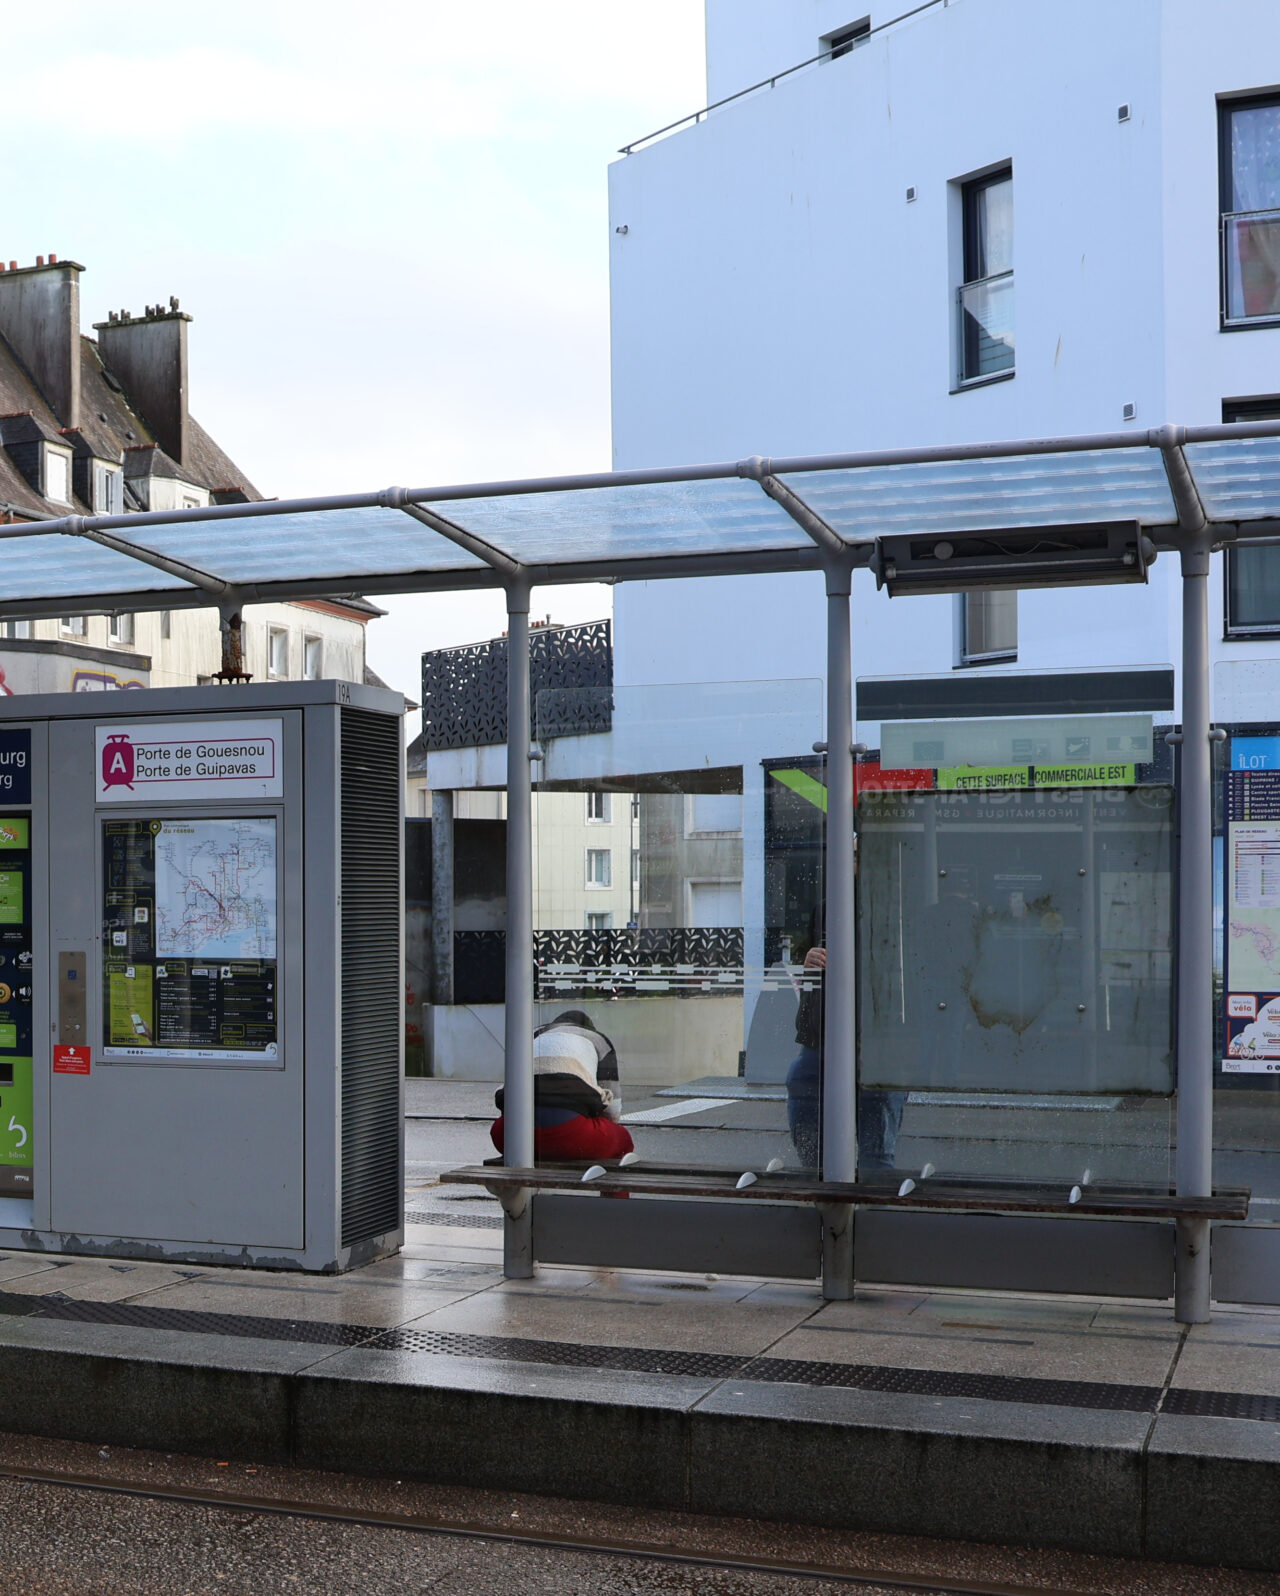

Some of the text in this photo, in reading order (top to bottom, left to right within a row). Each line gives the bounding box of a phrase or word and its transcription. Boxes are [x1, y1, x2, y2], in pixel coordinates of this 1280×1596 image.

[338, 684, 351, 703] 19A
[136, 743, 266, 761] Porte de Gouesnou
[110, 752, 127, 773] A
[136, 762, 257, 778] Porte de Guipavas
[956, 772, 1027, 789] CETTE SURFACE
[1034, 766, 1128, 785] COMMERCIALE EST
